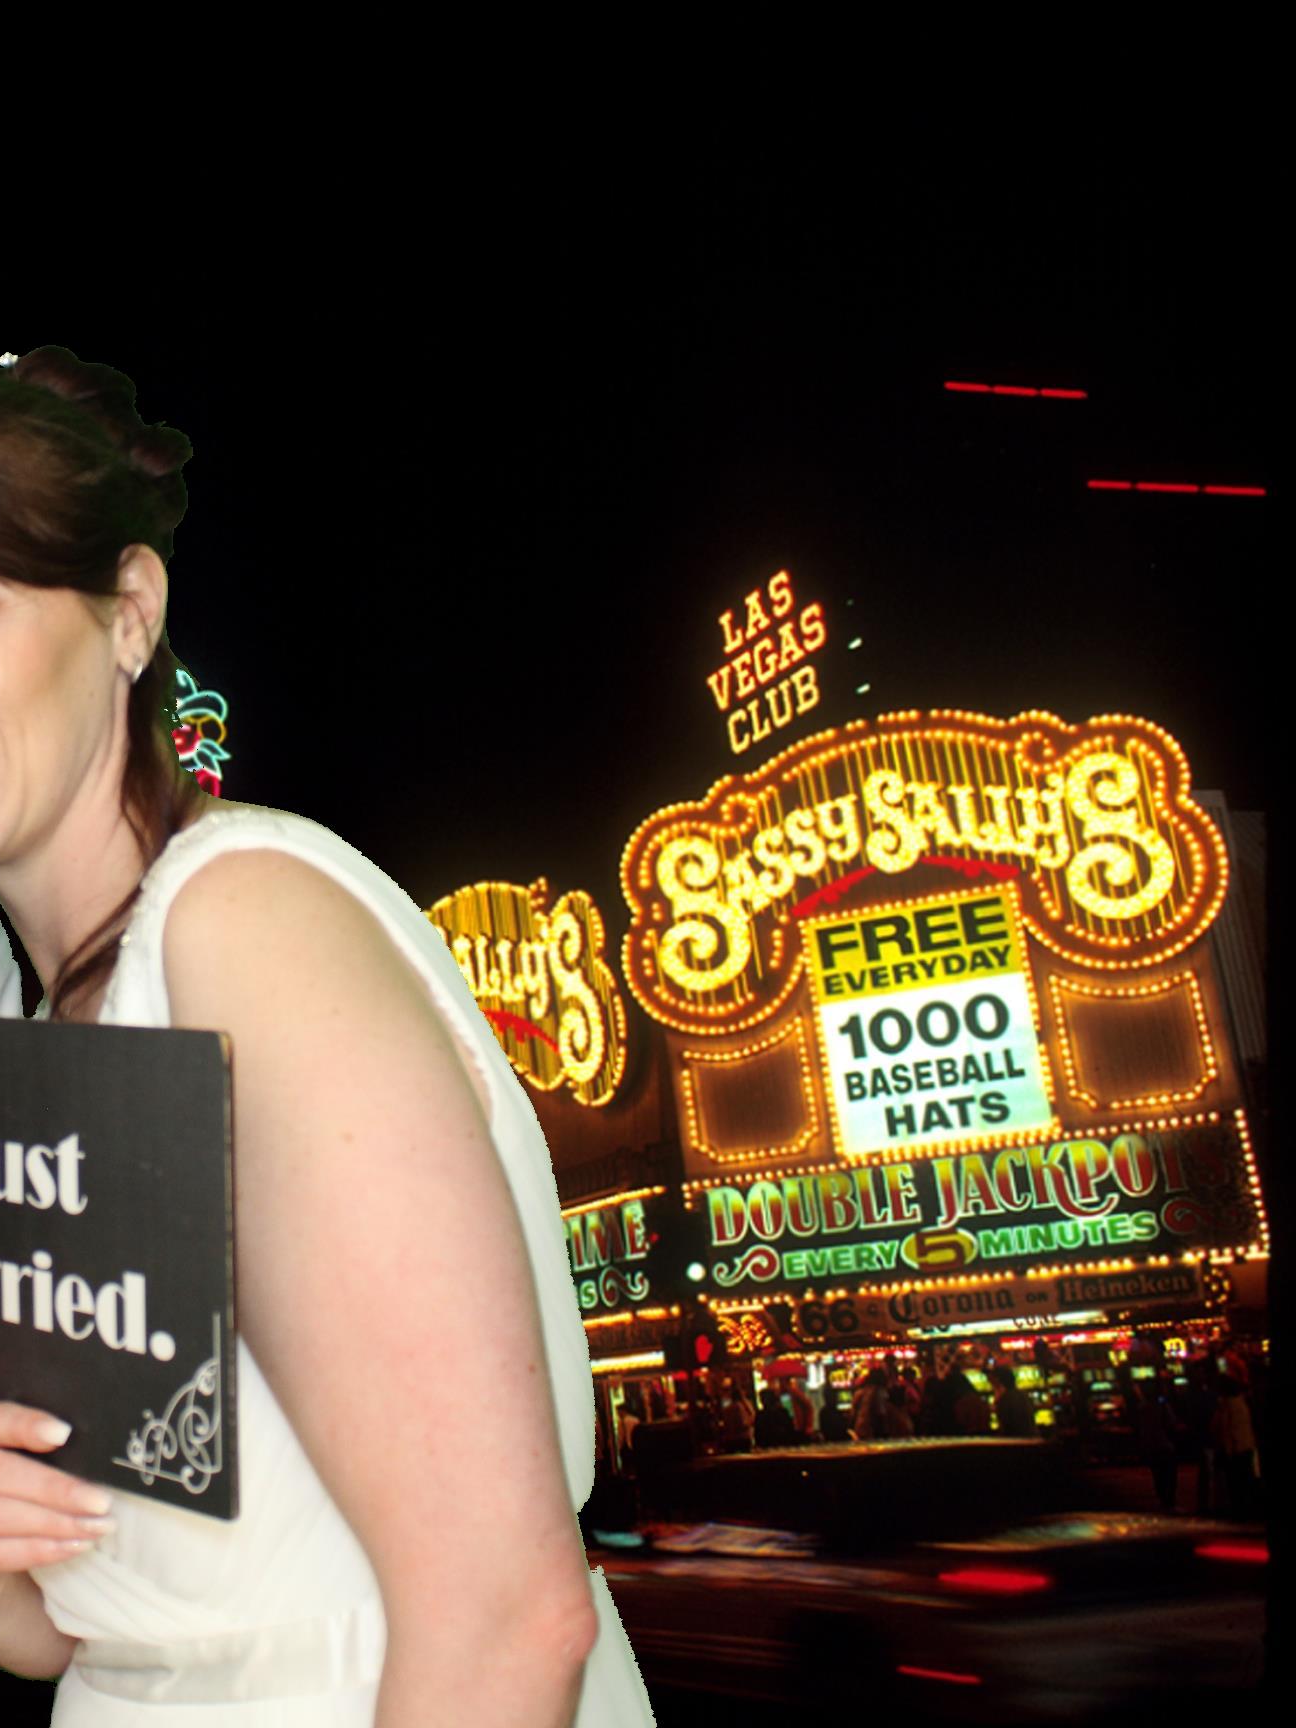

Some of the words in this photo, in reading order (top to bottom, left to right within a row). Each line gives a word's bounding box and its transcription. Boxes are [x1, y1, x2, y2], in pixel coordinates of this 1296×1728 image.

[717, 569, 794, 654] LAS
[706, 602, 827, 711] VEGAS
[727, 665, 820, 754] CLUB
[656, 793, 862, 992] SASSY
[815, 896, 1009, 970] FREE
[823, 945, 1011, 996] EVERYDAY
[839, 993, 1010, 1060] 1000
[844, 1048, 1026, 1102] BASEBALL
[885, 1091, 1011, 1137] HATS
[706, 1163, 923, 1246] DOUBLE
[782, 1240, 900, 1279] EVERY
[914, 1229, 967, 1274] 5
[978, 1211, 1160, 1259] MINUTES
[1061, 1268, 1192, 1302] Heineken
